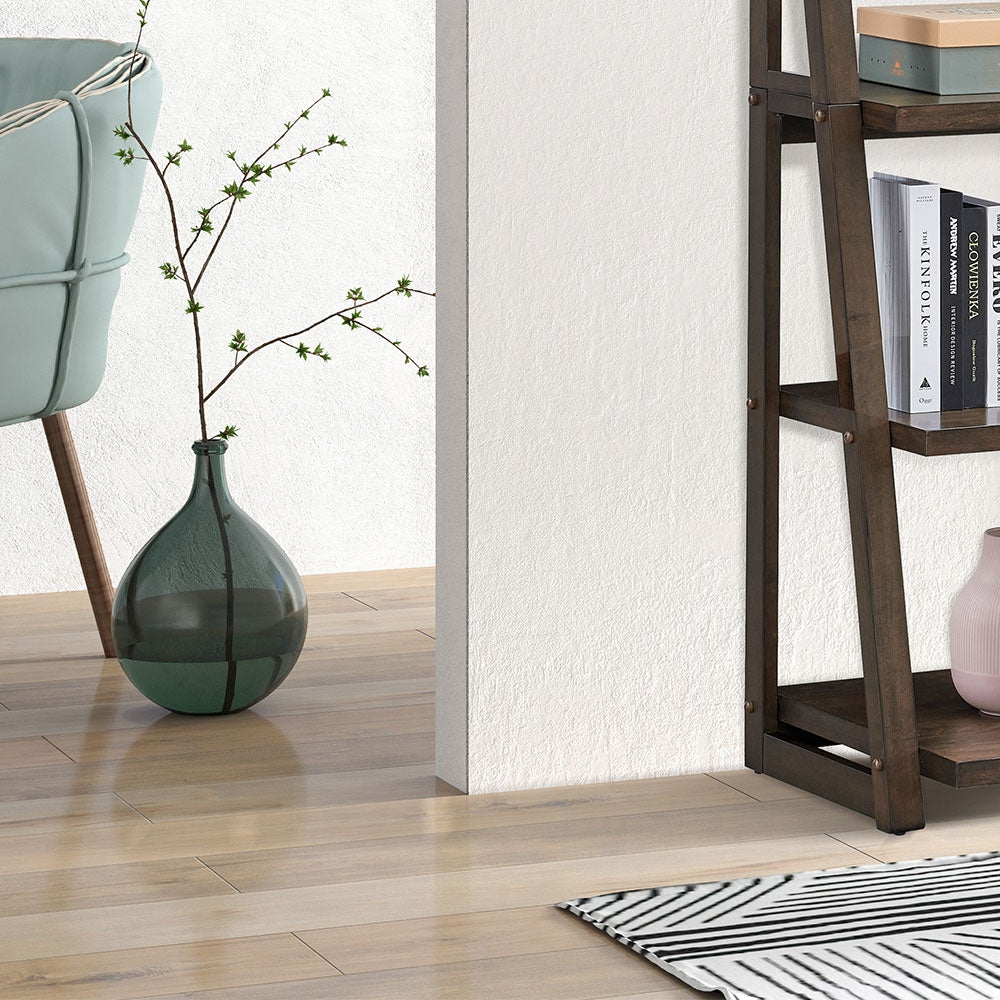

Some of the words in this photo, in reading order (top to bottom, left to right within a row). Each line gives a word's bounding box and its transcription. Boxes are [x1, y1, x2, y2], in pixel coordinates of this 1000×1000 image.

[949, 216, 958, 258] ANDREW
[920, 246, 931, 325] KINFOLK
[949, 259, 958, 295] MARTIN
